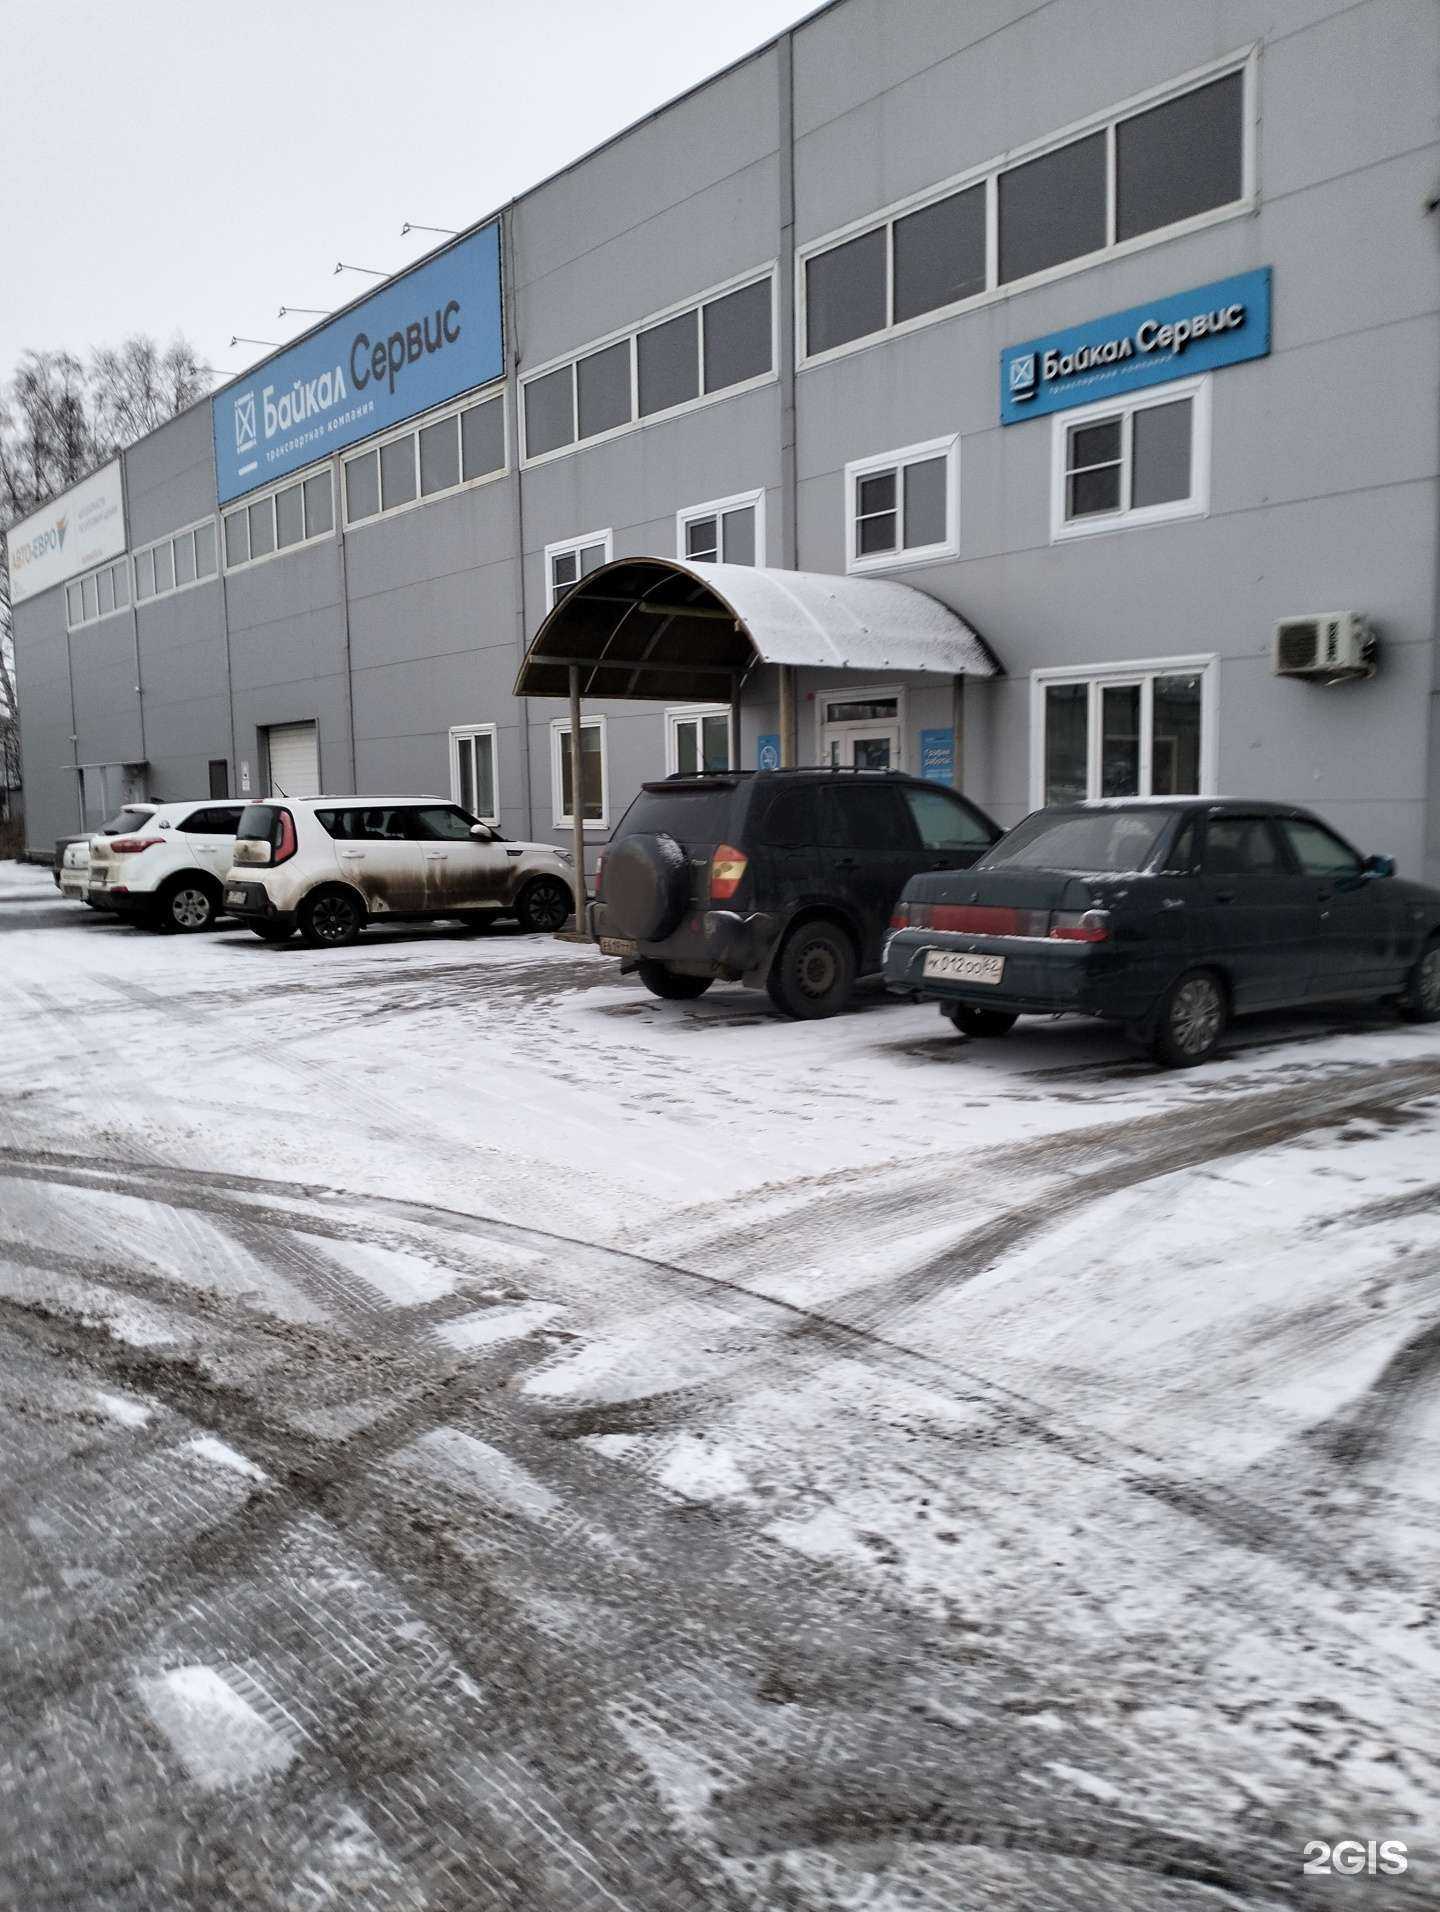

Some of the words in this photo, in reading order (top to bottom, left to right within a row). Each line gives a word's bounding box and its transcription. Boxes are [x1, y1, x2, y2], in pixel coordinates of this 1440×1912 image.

[262, 366, 347, 439] Байкал
[351, 300, 461, 395] Сервис
[1043, 336, 1133, 381] Байкал
[1136, 304, 1244, 353] Сервис
[266, 428, 325, 463] транспортная
[327, 400, 376, 434] компания
